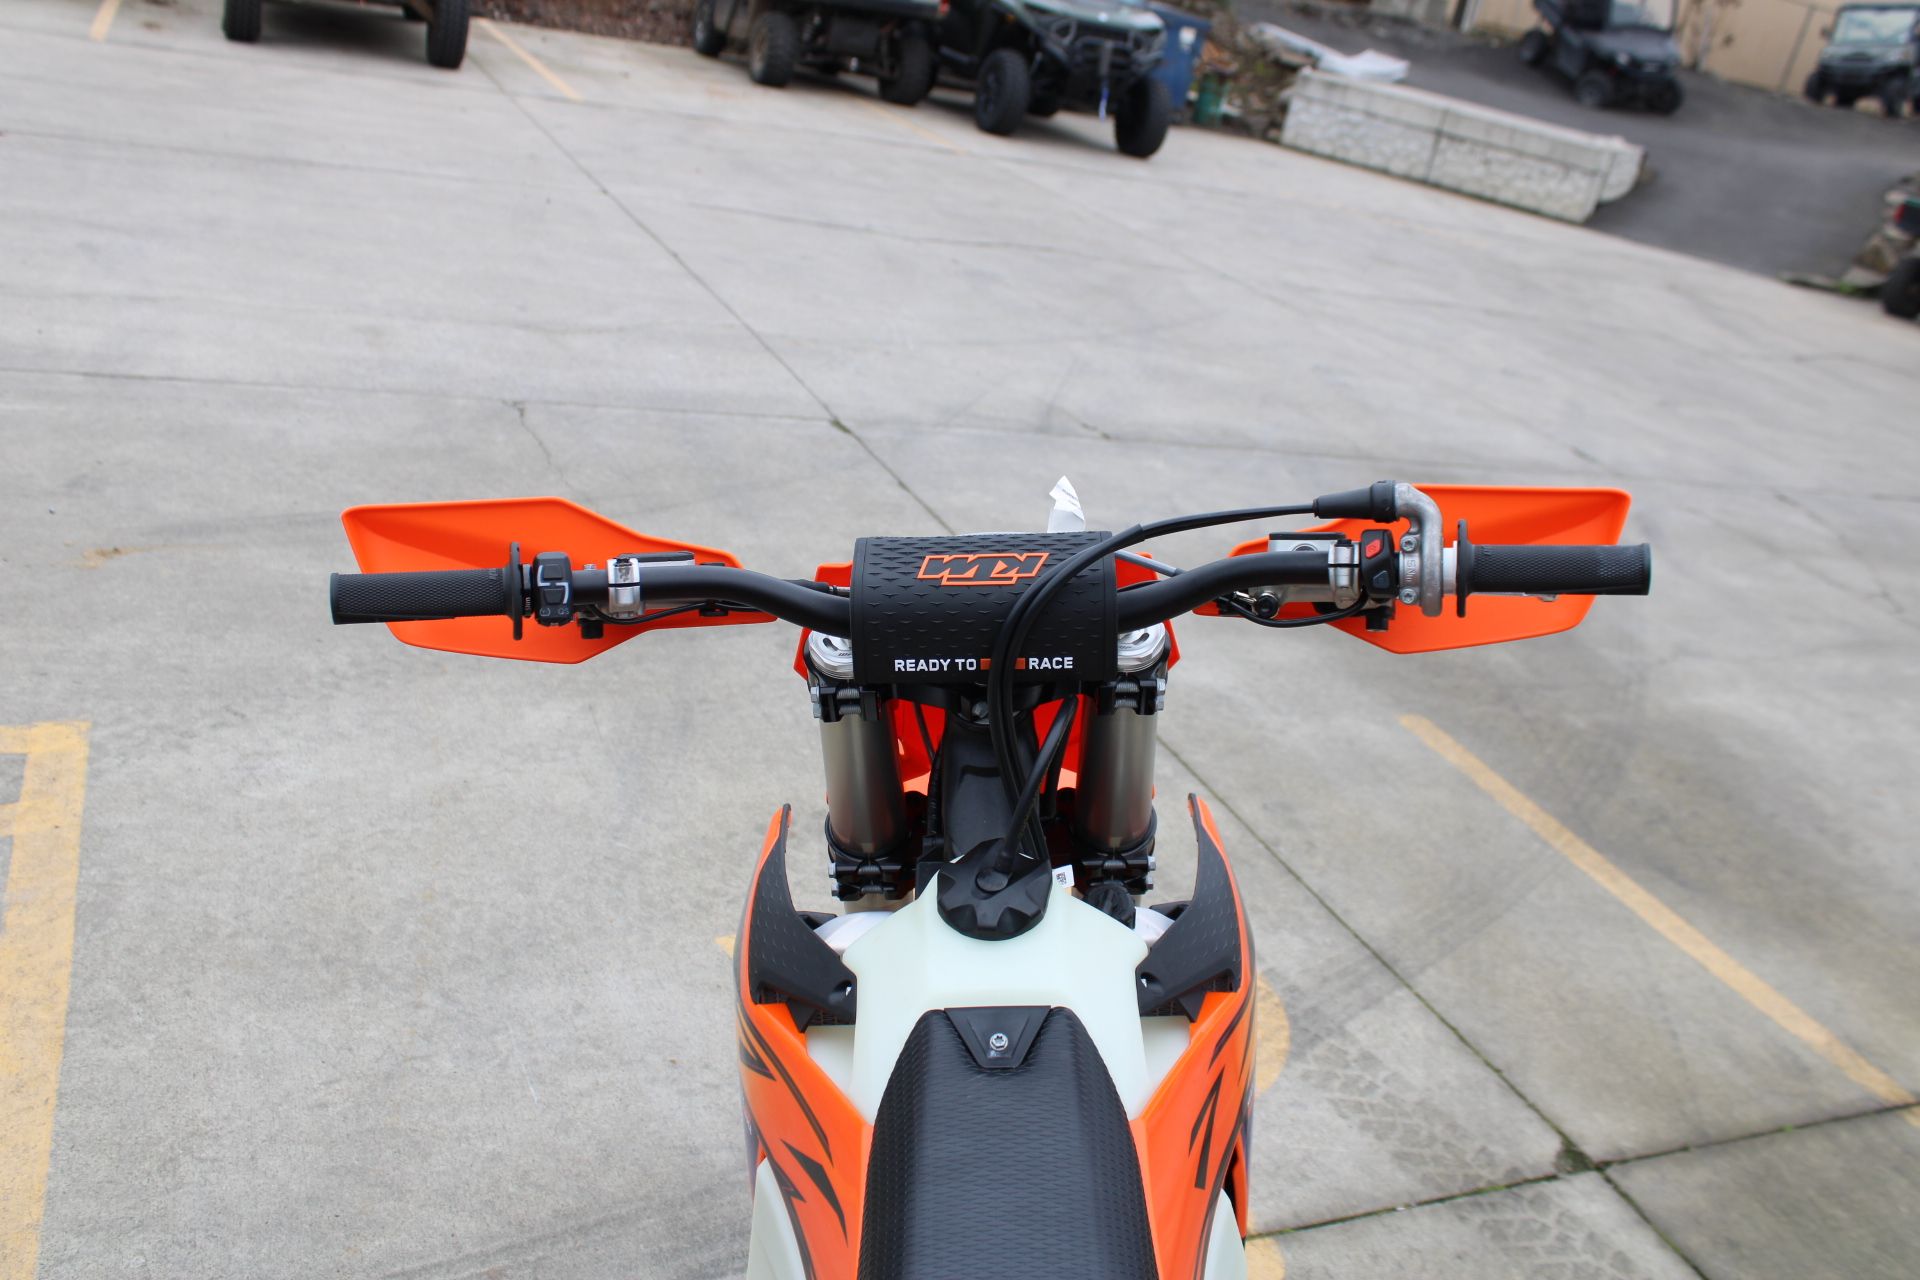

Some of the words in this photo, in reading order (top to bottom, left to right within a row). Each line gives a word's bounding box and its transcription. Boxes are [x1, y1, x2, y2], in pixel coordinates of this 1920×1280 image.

[917, 553, 1050, 586] KTM
[894, 659, 951, 672] READY
[955, 658, 977, 671] TO
[1028, 656, 1074, 670] RACE
